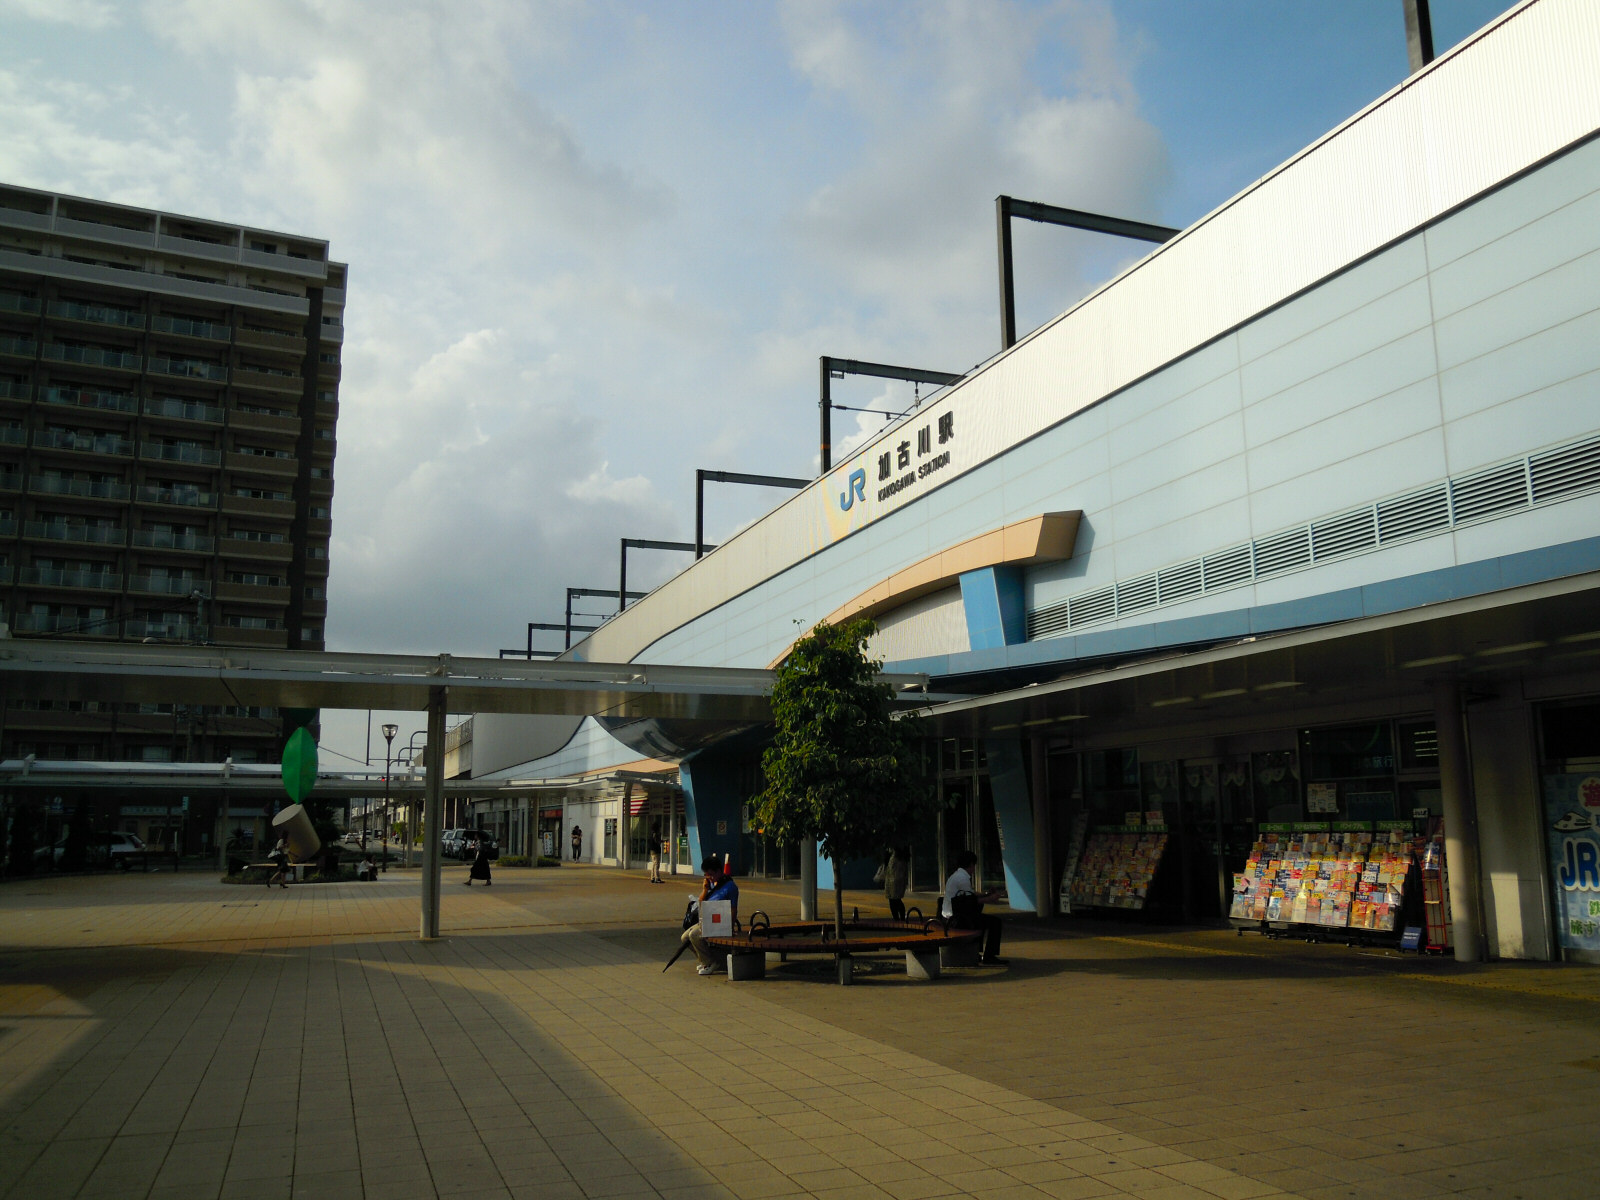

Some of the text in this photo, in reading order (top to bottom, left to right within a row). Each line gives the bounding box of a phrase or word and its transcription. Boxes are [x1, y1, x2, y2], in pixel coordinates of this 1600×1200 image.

[878, 410, 954, 482] 加古川駅
[840, 467, 866, 511] JR
[878, 450, 951, 502] KAKOGAWA STATION
